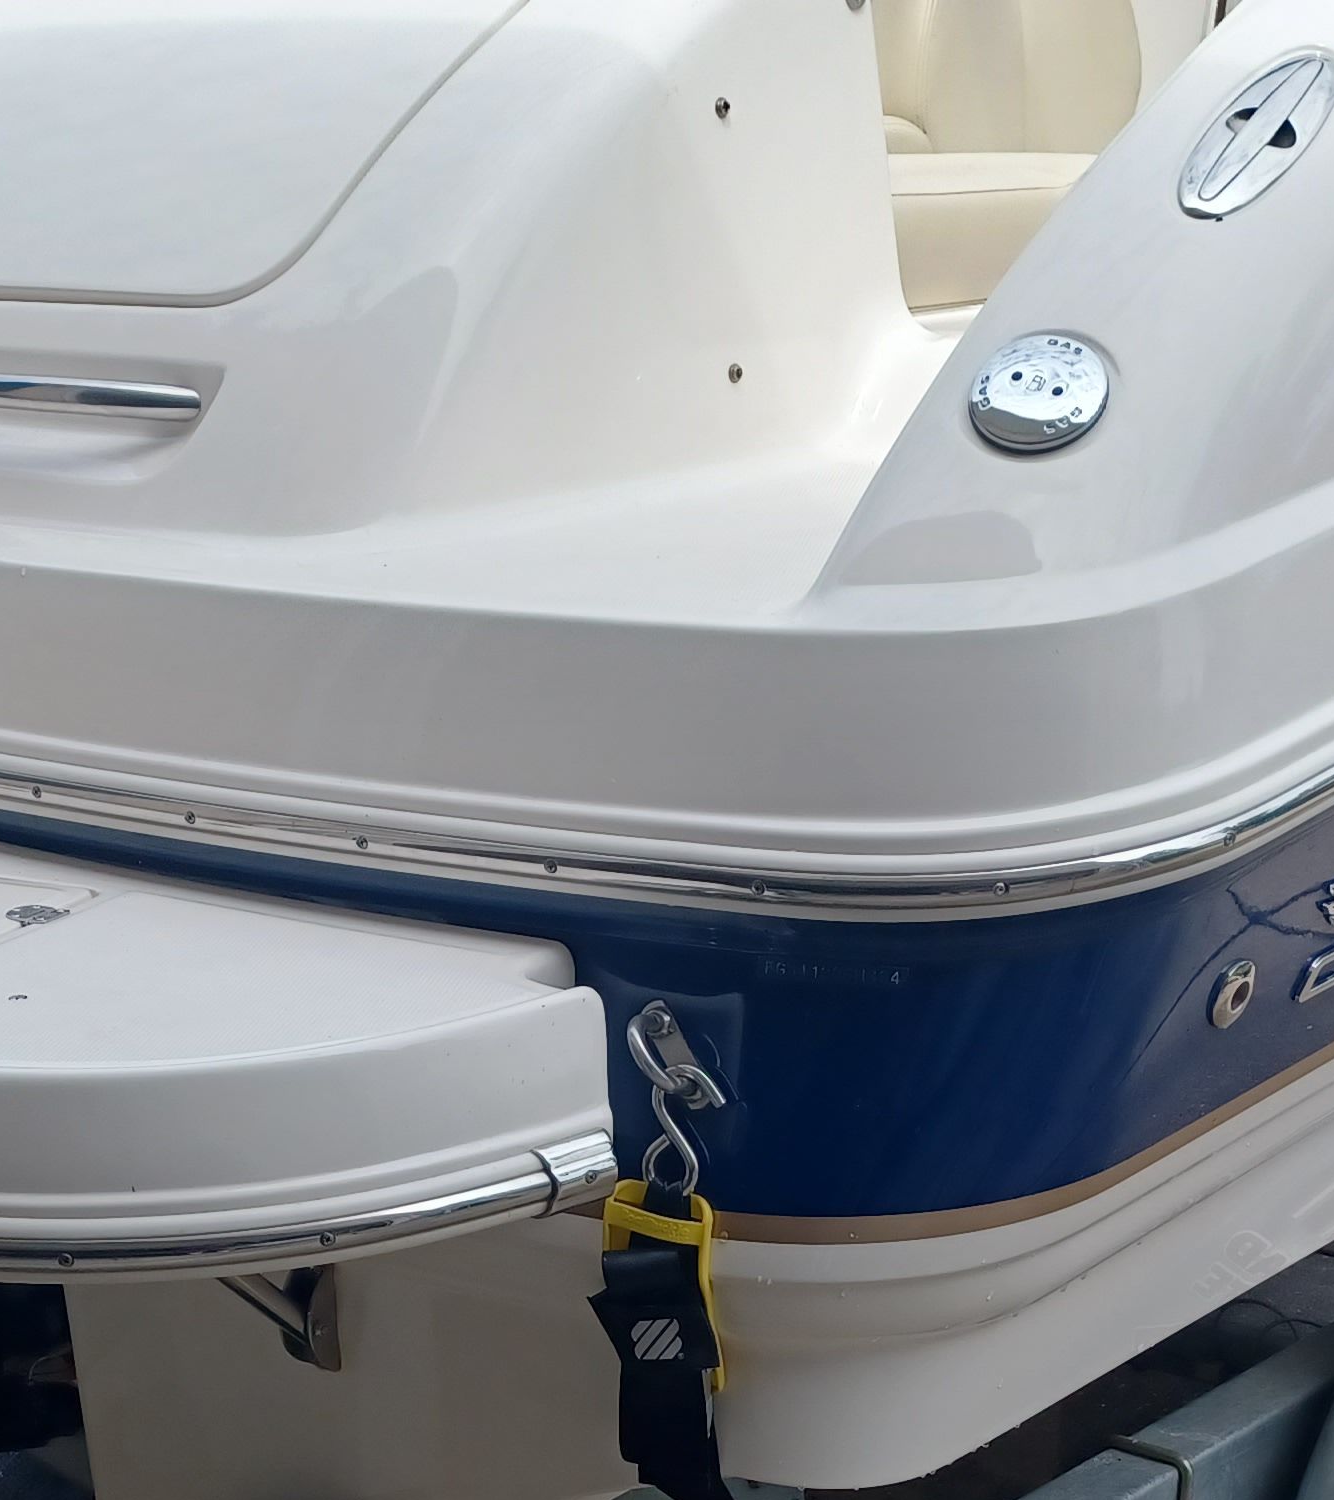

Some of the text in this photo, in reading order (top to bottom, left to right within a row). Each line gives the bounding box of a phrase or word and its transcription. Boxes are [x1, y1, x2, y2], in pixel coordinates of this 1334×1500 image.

[1047, 338, 1083, 355] GAS
[977, 375, 991, 411] GAS
[1043, 406, 1083, 434] GAS
